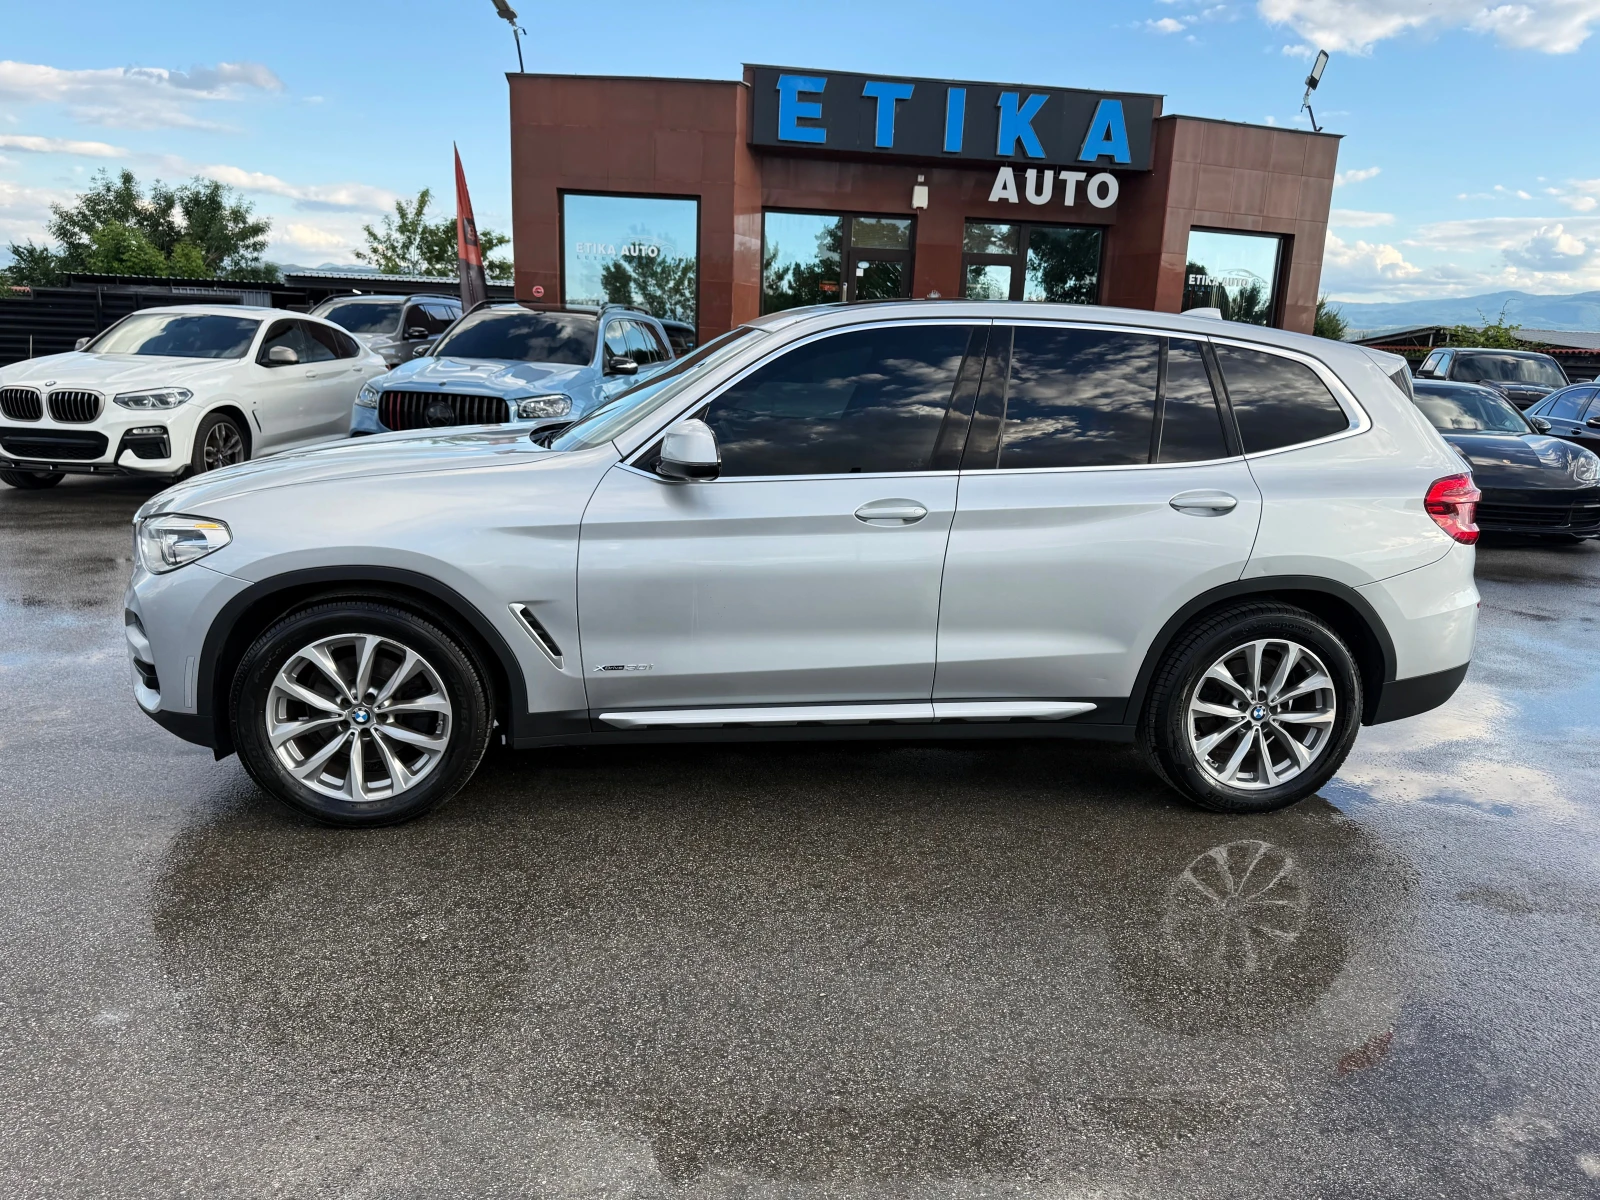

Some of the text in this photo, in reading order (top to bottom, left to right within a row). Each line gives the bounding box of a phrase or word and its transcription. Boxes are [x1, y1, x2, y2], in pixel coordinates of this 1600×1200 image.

[776, 74, 1132, 164] ETIKA
[988, 166, 1120, 209] AUTO
[576, 242, 658, 257] ETIKA AUTO
[1188, 274, 1249, 288] ETIKA AUTO
